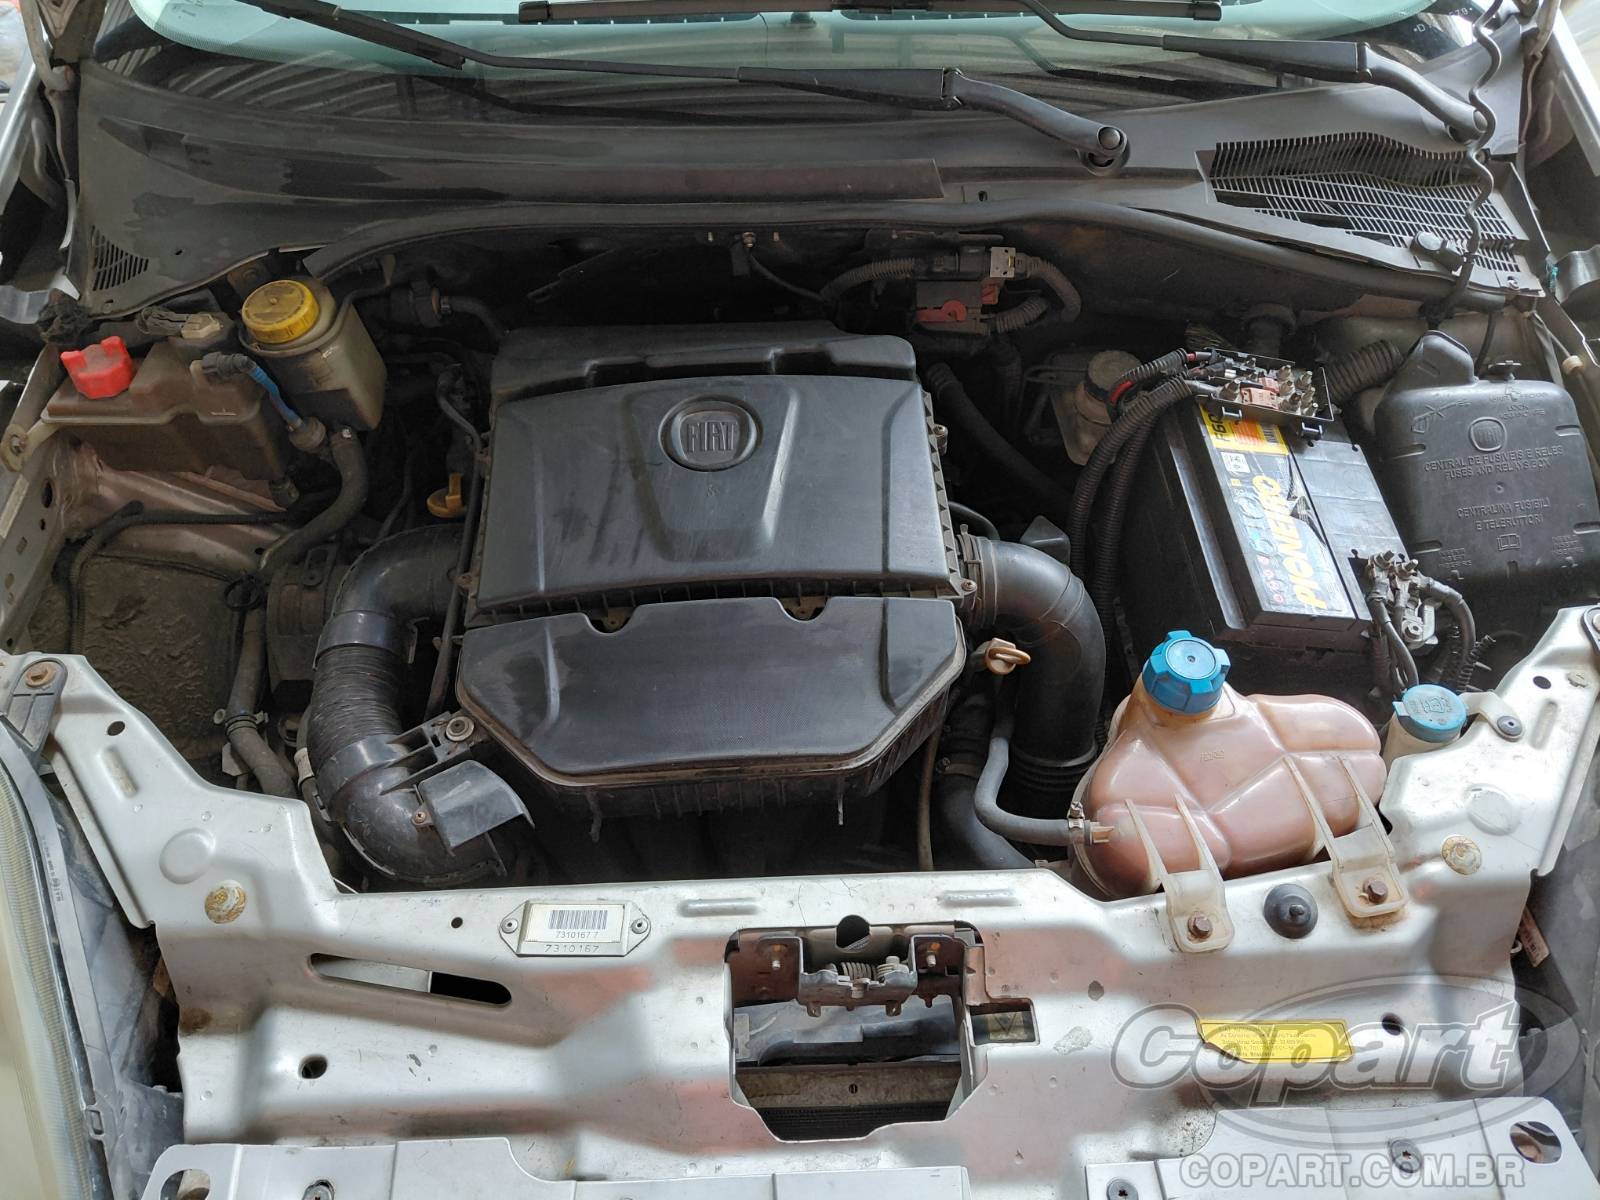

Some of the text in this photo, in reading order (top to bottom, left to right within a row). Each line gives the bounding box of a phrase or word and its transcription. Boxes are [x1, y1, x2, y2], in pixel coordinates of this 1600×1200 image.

[686, 421, 737, 453] FIAT
[1424, 457, 1467, 472] CENTRAL
[1468, 455, 1482, 466] DE
[1446, 467, 1473, 480] FUSES
[1477, 464, 1493, 475] AND
[1495, 459, 1529, 472] RELAYS
[1457, 503, 1513, 518] CENTRALINA
[1252, 474, 1328, 609] PIONEIRO
[544, 944, 600, 953] 7310167
